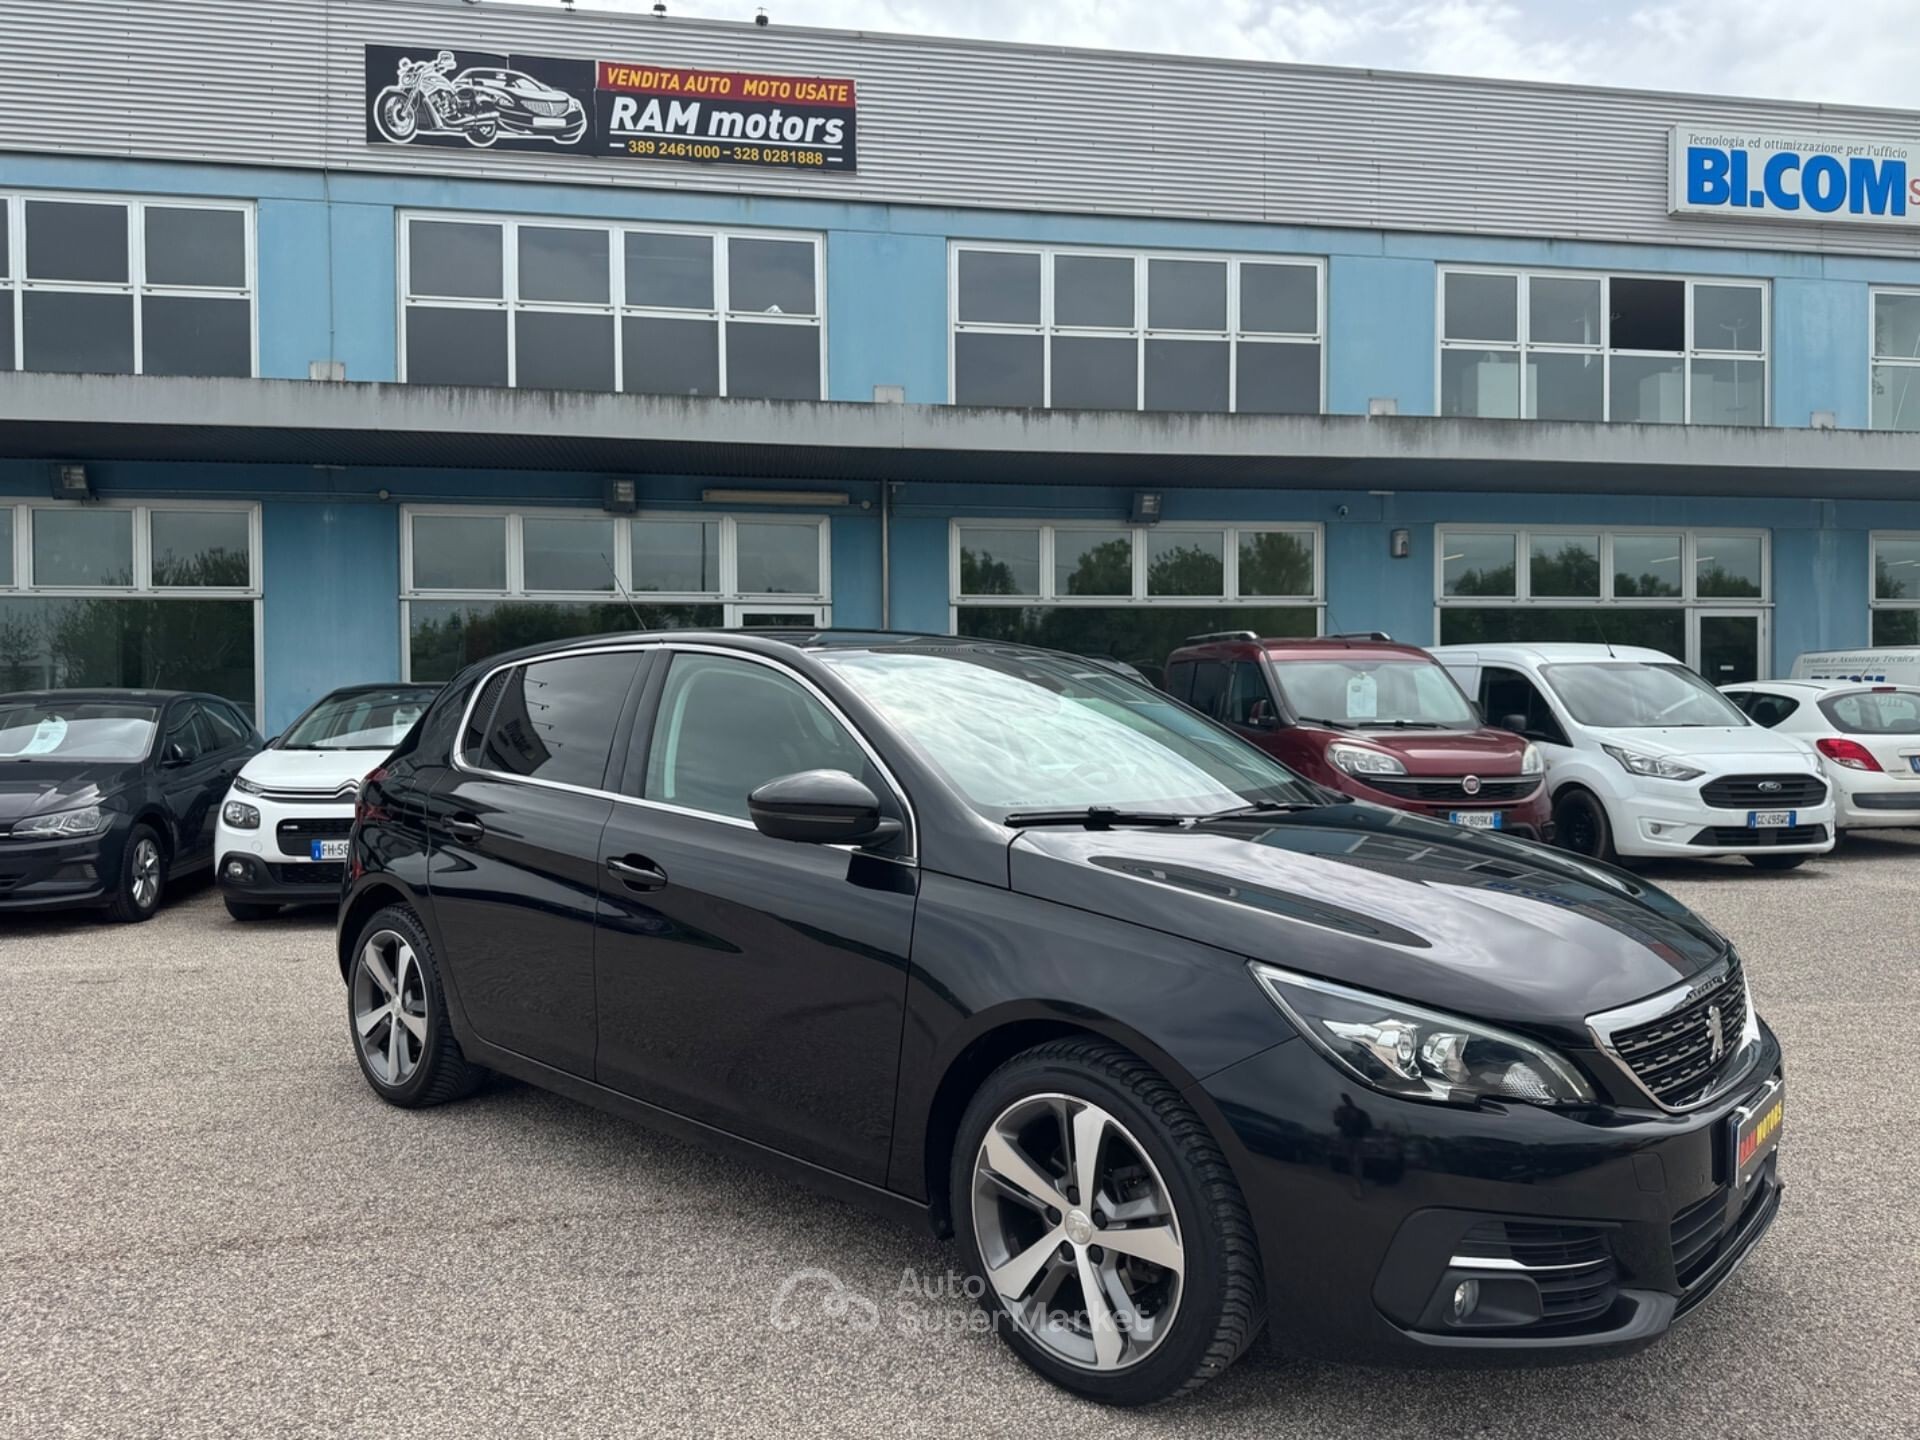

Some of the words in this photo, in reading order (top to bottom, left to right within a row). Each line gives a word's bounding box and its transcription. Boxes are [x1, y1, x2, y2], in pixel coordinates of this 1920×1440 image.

[607, 67, 680, 91] VENDITA
[683, 76, 731, 95] AUTO
[743, 80, 792, 99] MOTO
[795, 85, 849, 102] USATE
[610, 96, 701, 134] RAM
[708, 109, 845, 144] motors
[628, 140, 655, 154] 389
[659, 142, 720, 159] 2461000
[733, 148, 760, 161] 328
[763, 149, 823, 165] 0281888
[1687, 134, 1745, 148] Tecnologia
[1748, 139, 1761, 148] ed
[1764, 139, 1844, 154] ottimizzazione
[1846, 145, 1863, 157] per
[1867, 145, 1908, 158] l'ufficio
[1687, 147, 1906, 216] BI.COM
